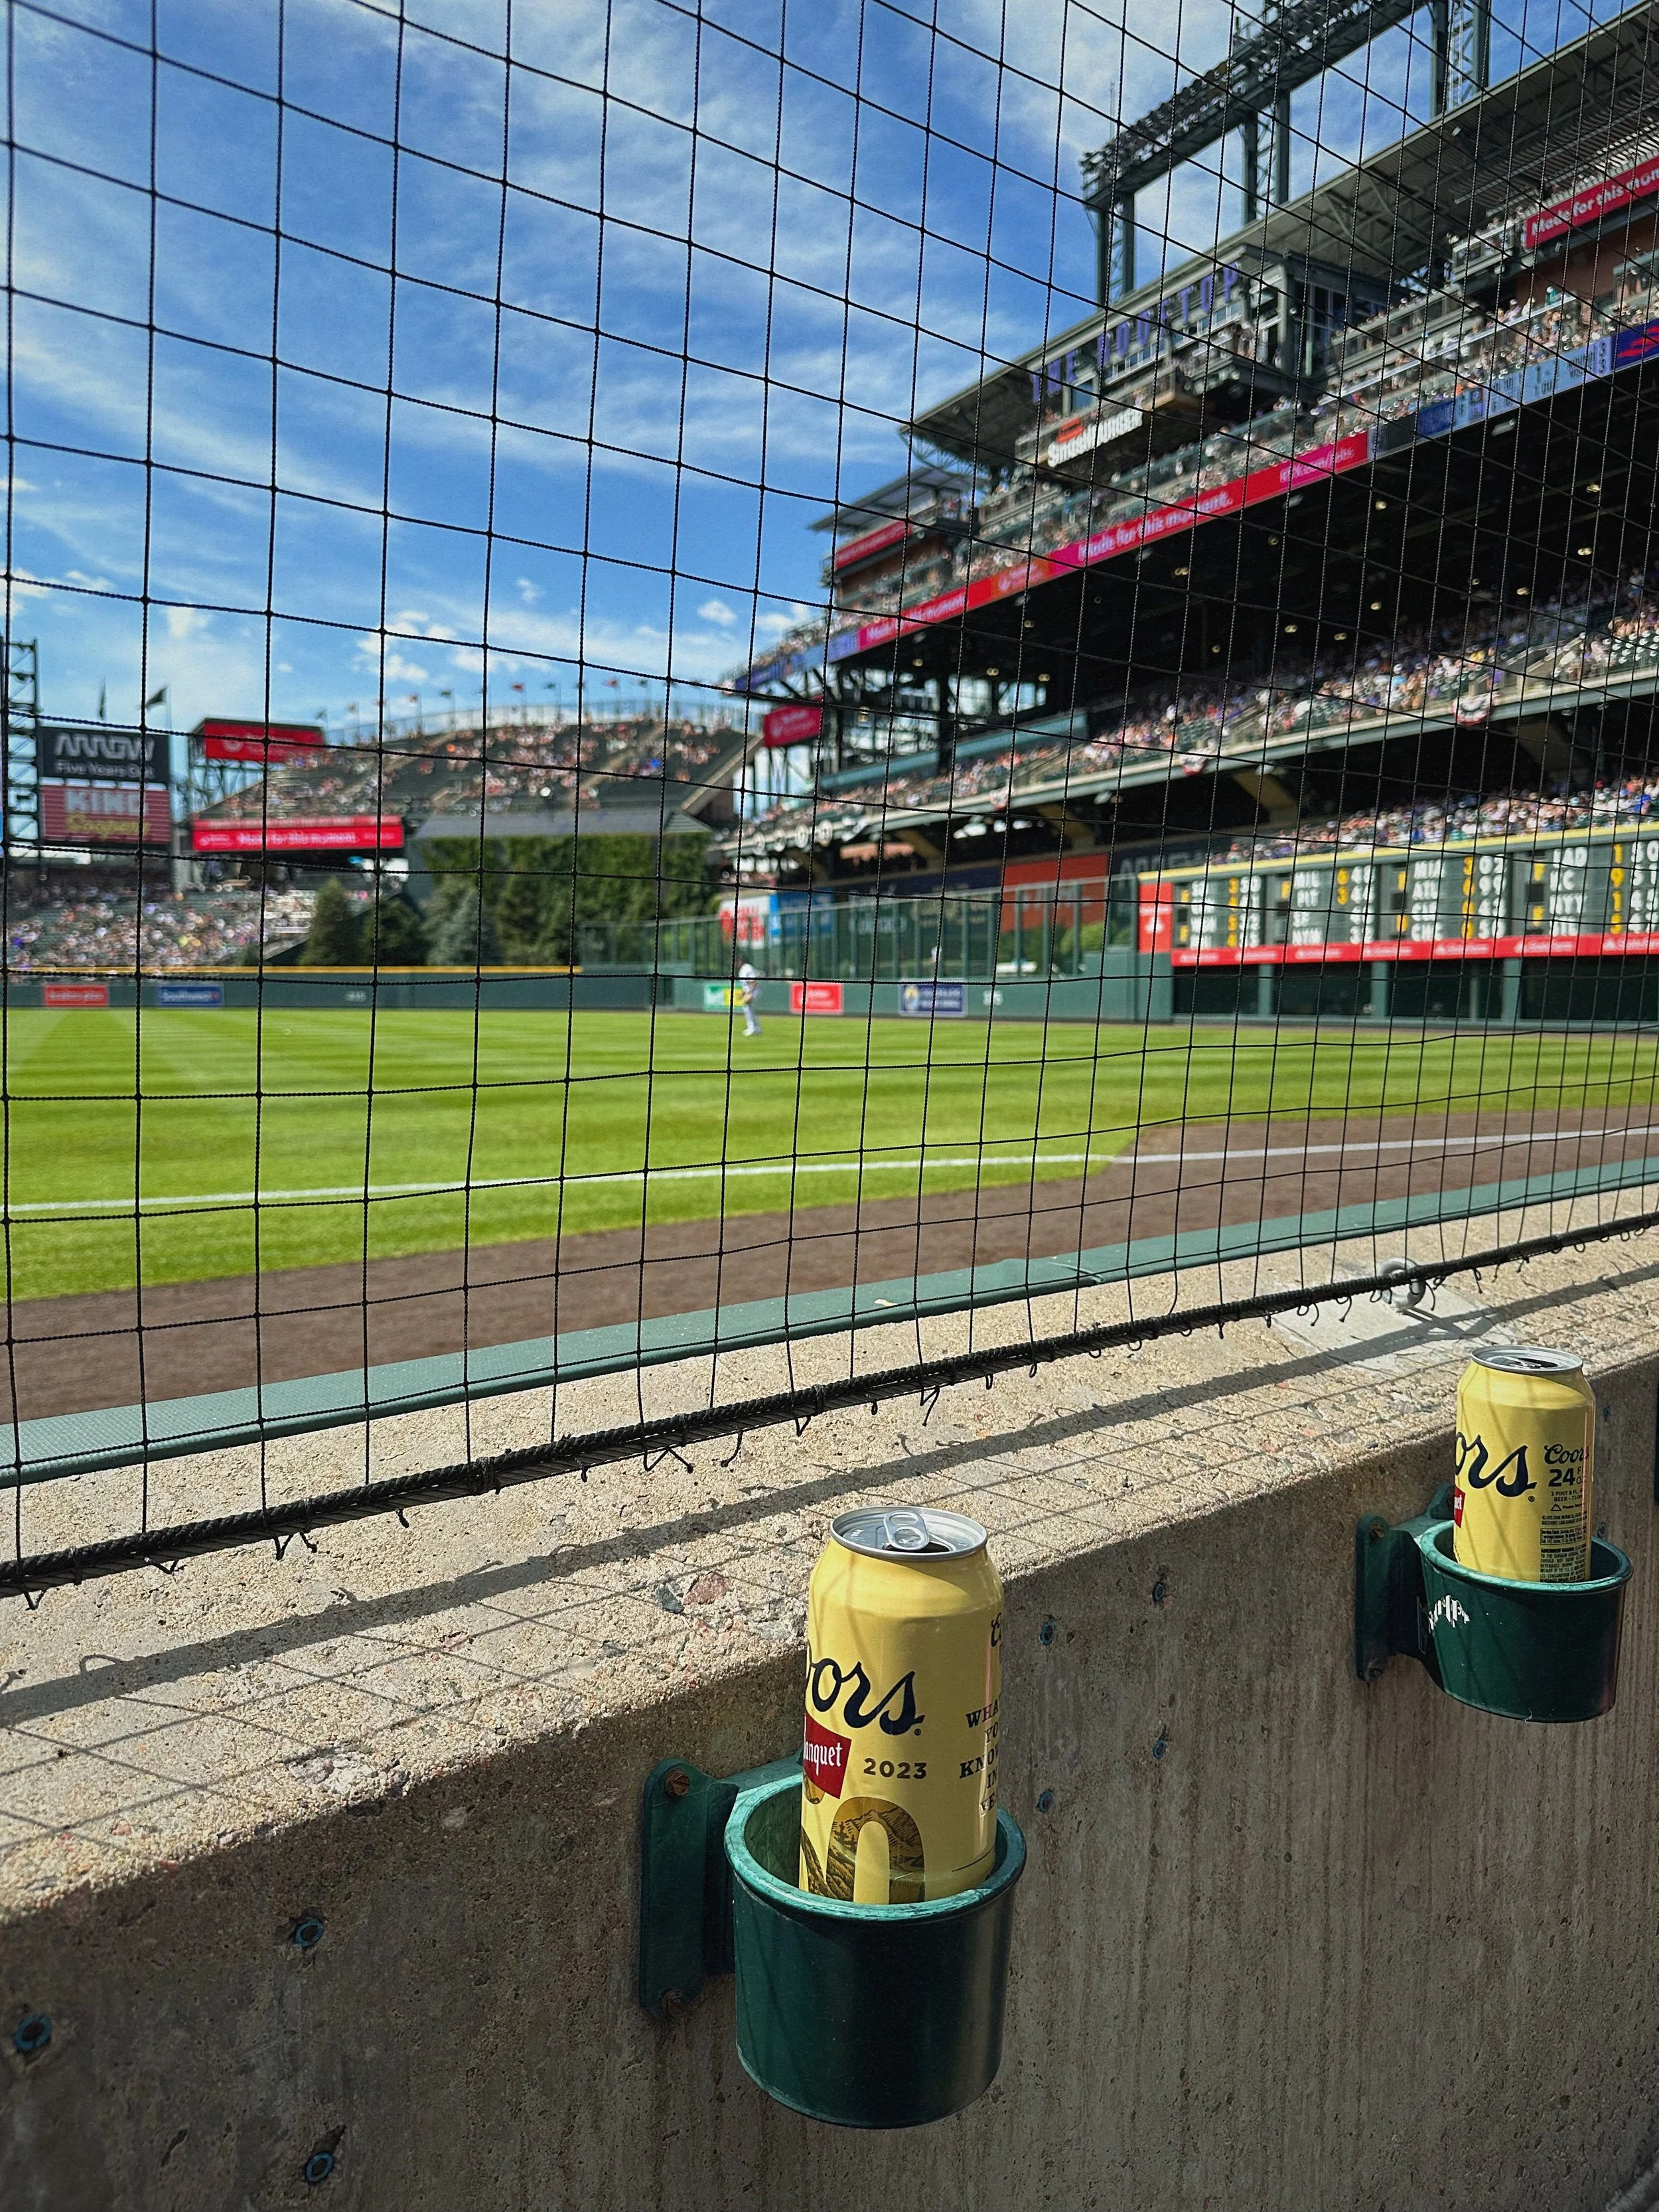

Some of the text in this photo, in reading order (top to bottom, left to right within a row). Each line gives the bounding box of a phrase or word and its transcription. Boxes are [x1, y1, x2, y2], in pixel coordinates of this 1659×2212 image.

[1532, 210, 1571, 236] Made
[1573, 198, 1595, 216] for
[1596, 184, 1624, 206] this
[1413, 859, 1446, 879] MIA
[1550, 869, 1575, 891] KC
[1412, 880, 1439, 900] ATL
[1548, 1468, 1575, 1487] 24
[966, 1698, 1000, 1728] WHA
[863, 1757, 927, 1780] 2023
